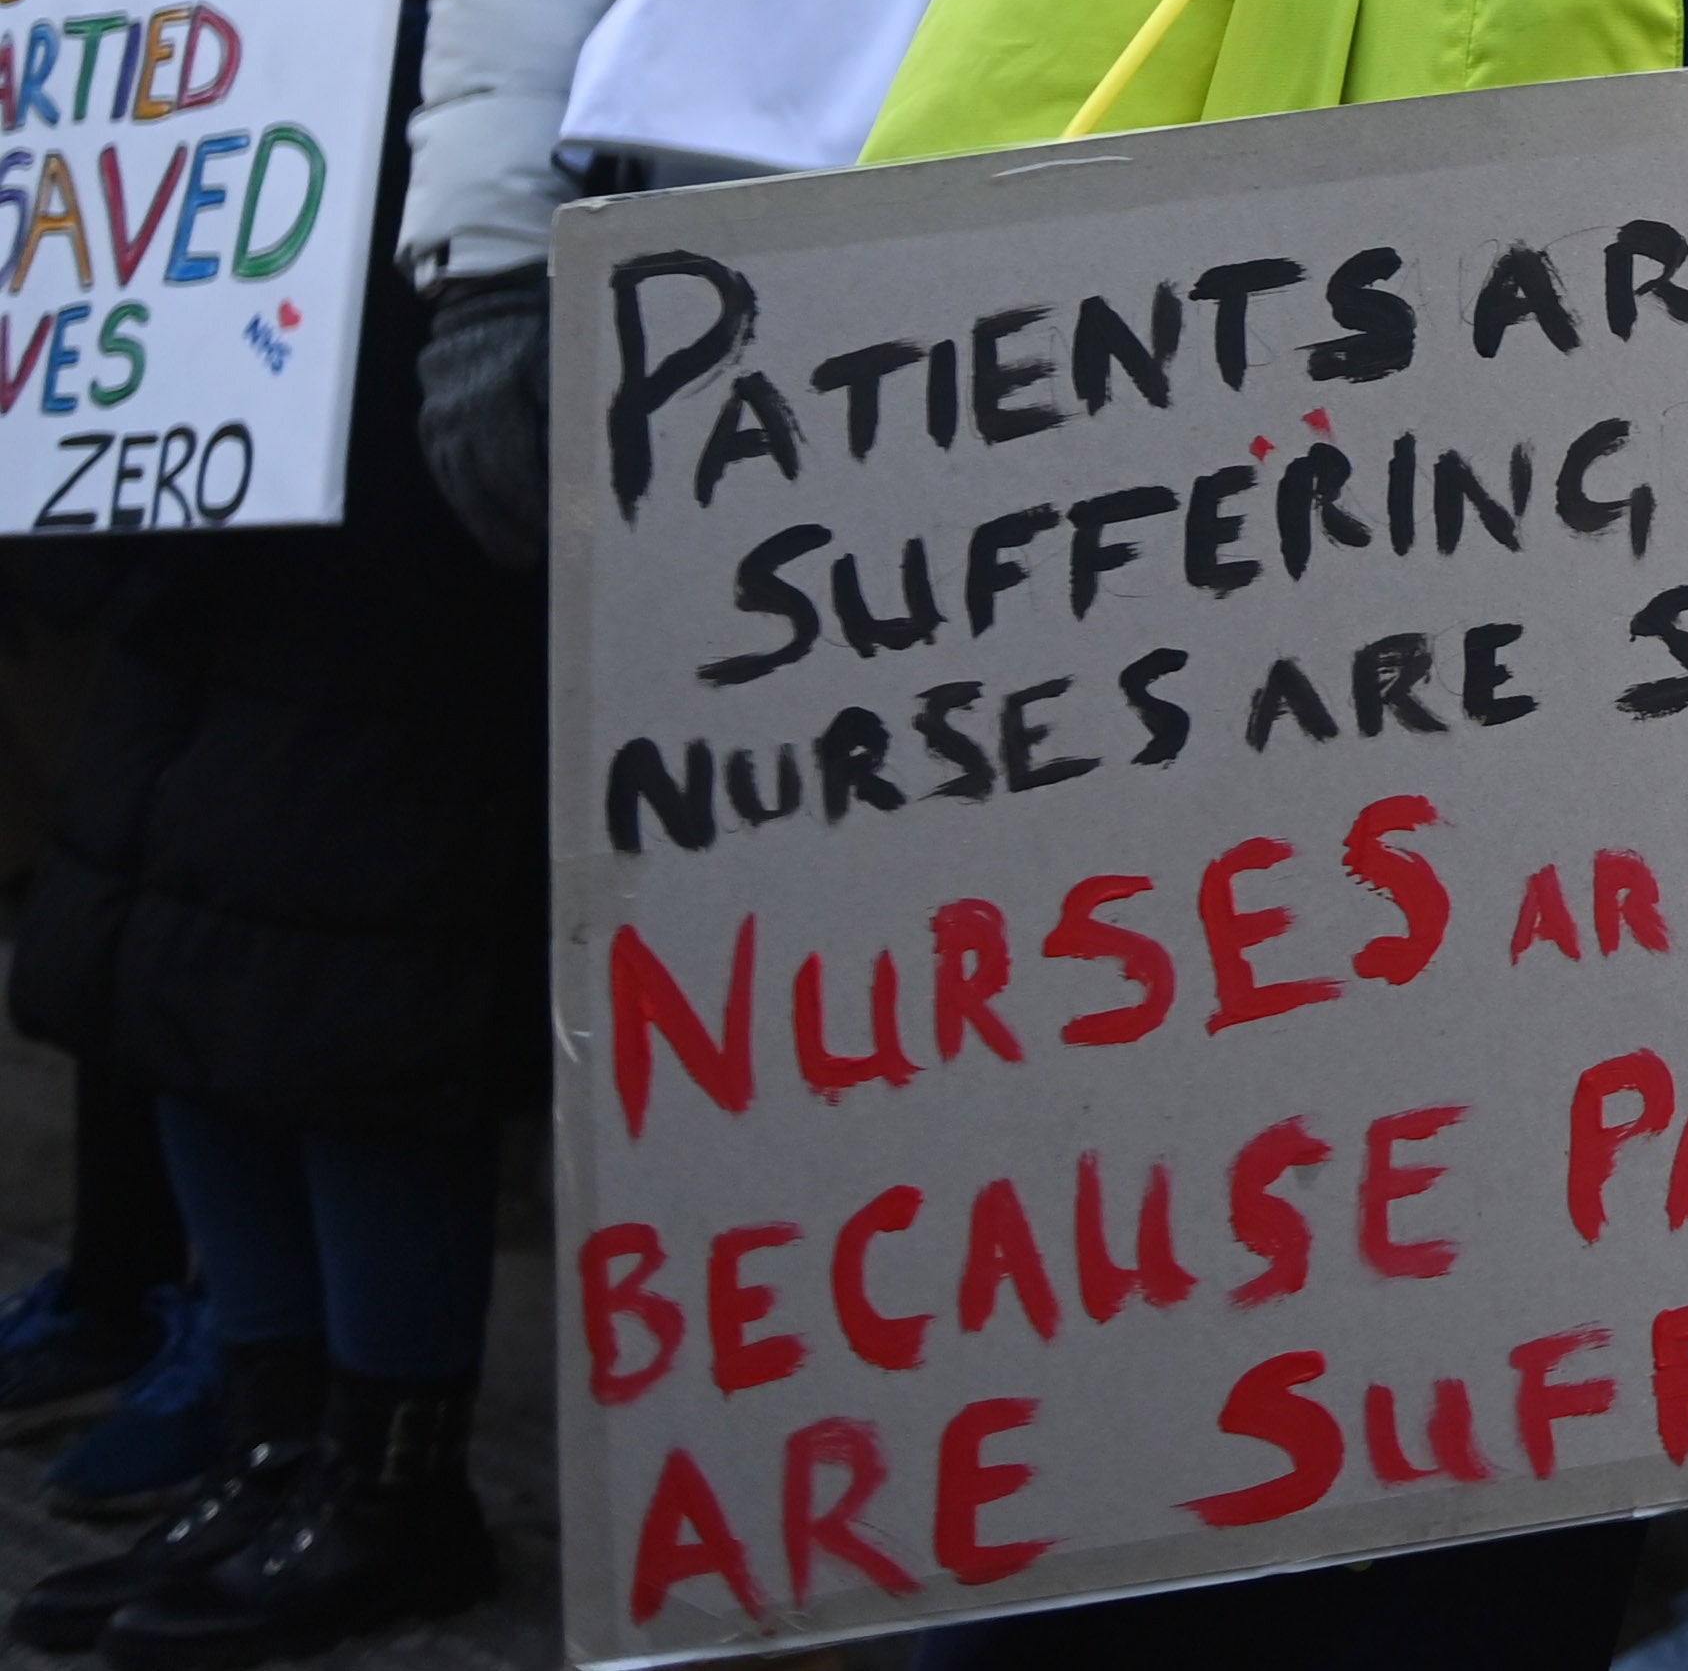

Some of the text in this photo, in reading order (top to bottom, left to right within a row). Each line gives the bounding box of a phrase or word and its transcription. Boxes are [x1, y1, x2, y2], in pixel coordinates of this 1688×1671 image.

[34, 419, 255, 531] ZERO
[607, 246, 1419, 527] PATIENTS
[696, 417, 1656, 689] SUFFERING
[606, 645, 1192, 855] NURSES
[1244, 622, 1540, 755] ARE
[610, 792, 1454, 1141] NURSES
[577, 1102, 1474, 1408] BECAUSE
[629, 1395, 1068, 1641] ARE
